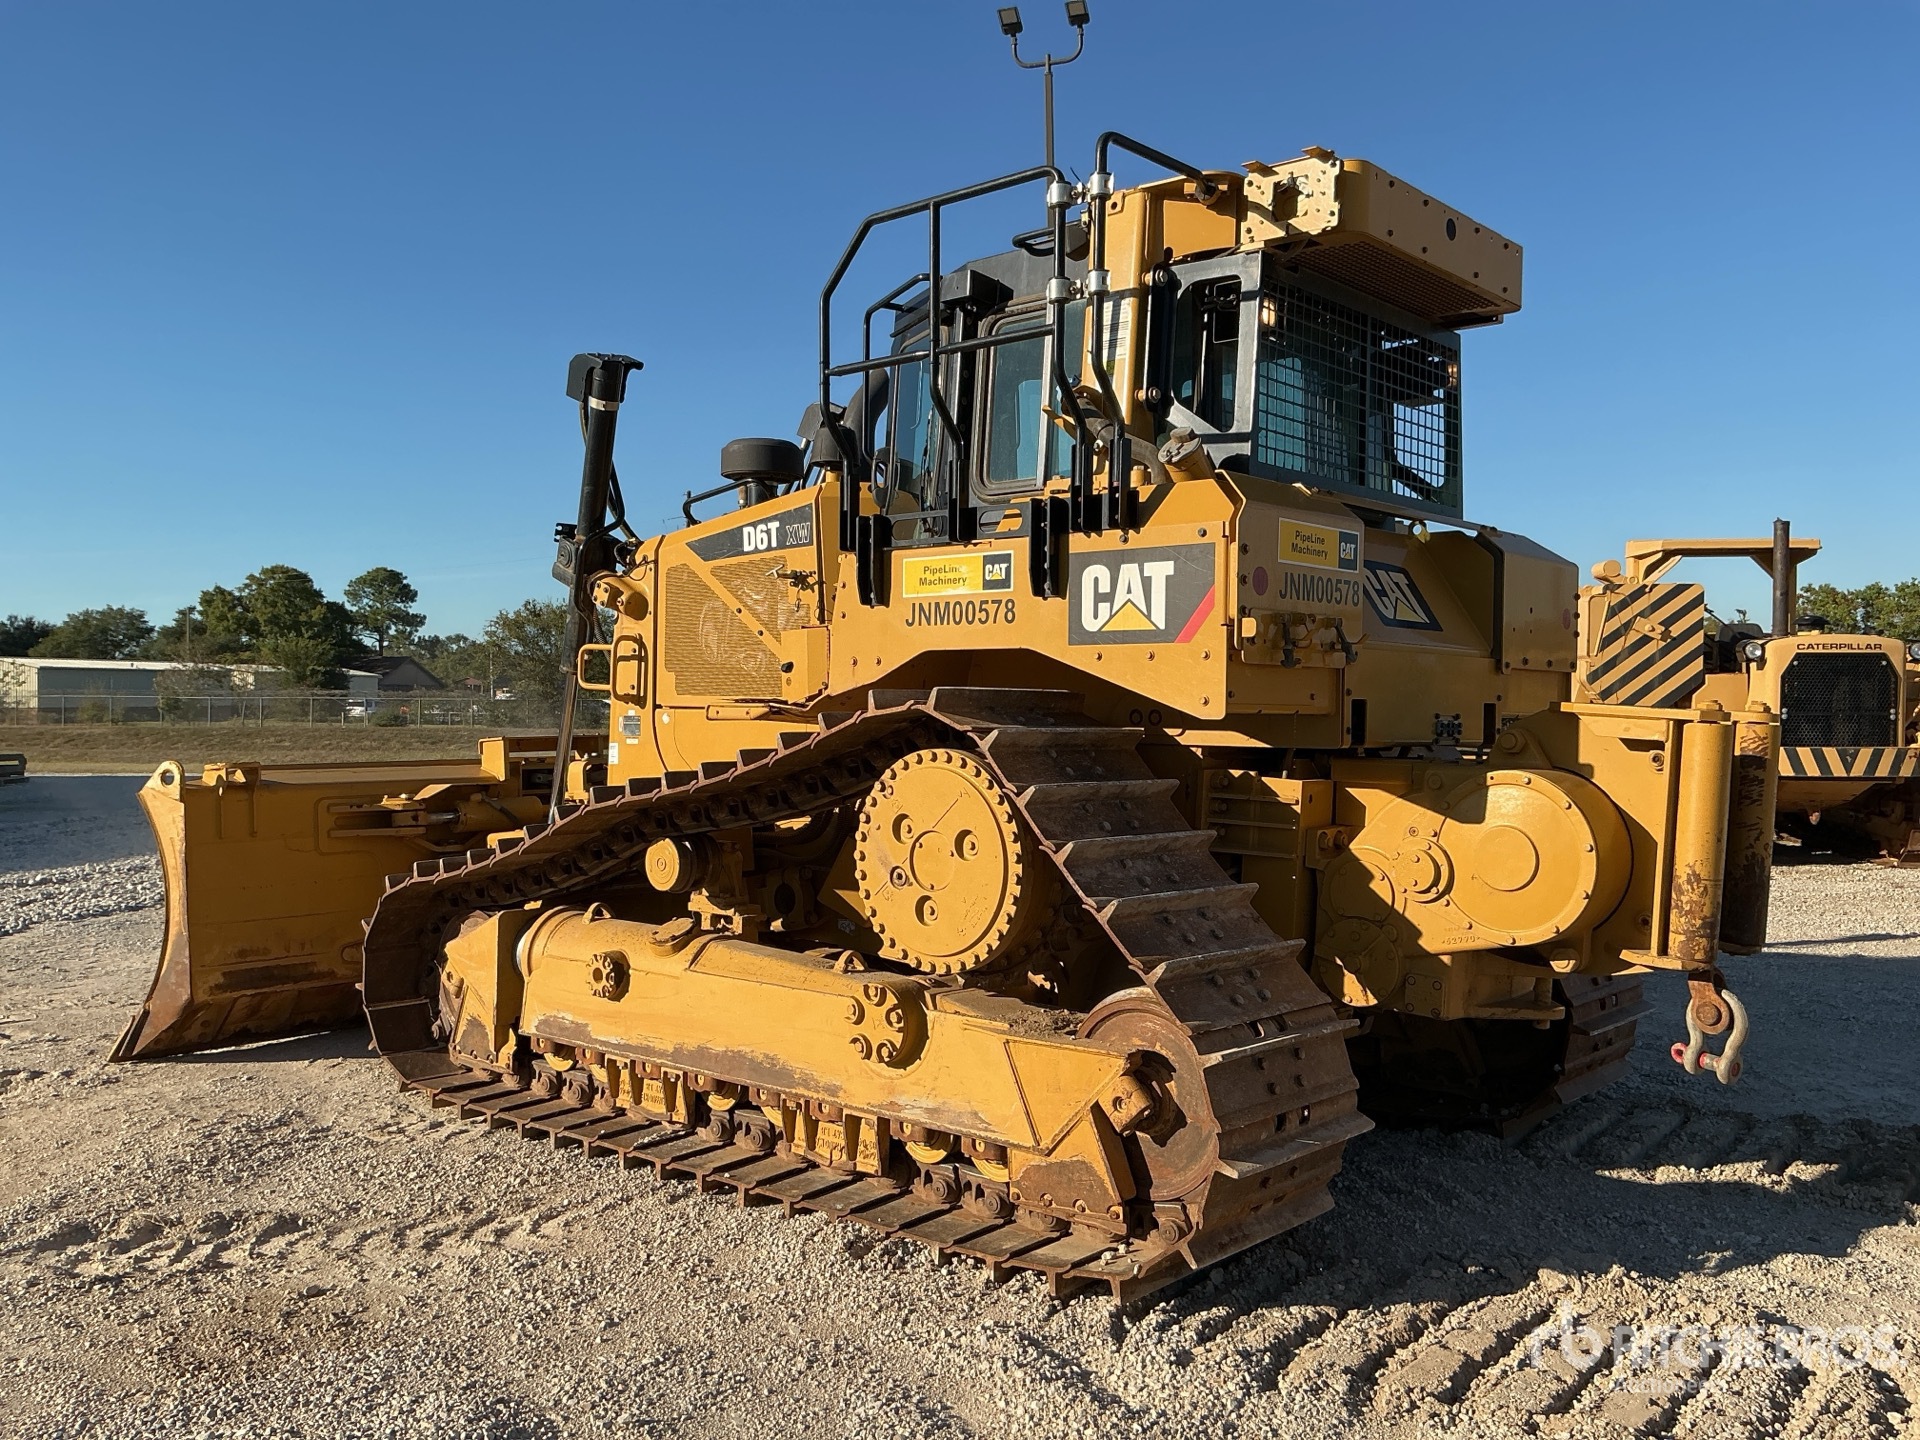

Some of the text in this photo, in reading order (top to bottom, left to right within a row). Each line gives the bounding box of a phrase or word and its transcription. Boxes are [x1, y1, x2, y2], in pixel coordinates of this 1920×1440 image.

[742, 521, 811, 552] D6T XW
[1295, 529, 1326, 546] PipeLine
[1291, 543, 1329, 560] Machinery
[1340, 542, 1356, 560] CAT
[985, 563, 1010, 581] CAT
[919, 576, 968, 587] Machinery
[1279, 571, 1360, 608] JNM00578
[1081, 561, 1175, 632] CAT
[1363, 567, 1431, 624] CAT
[905, 598, 1016, 628] JNM00578
[1796, 642, 1883, 651] CATERPILLAR
